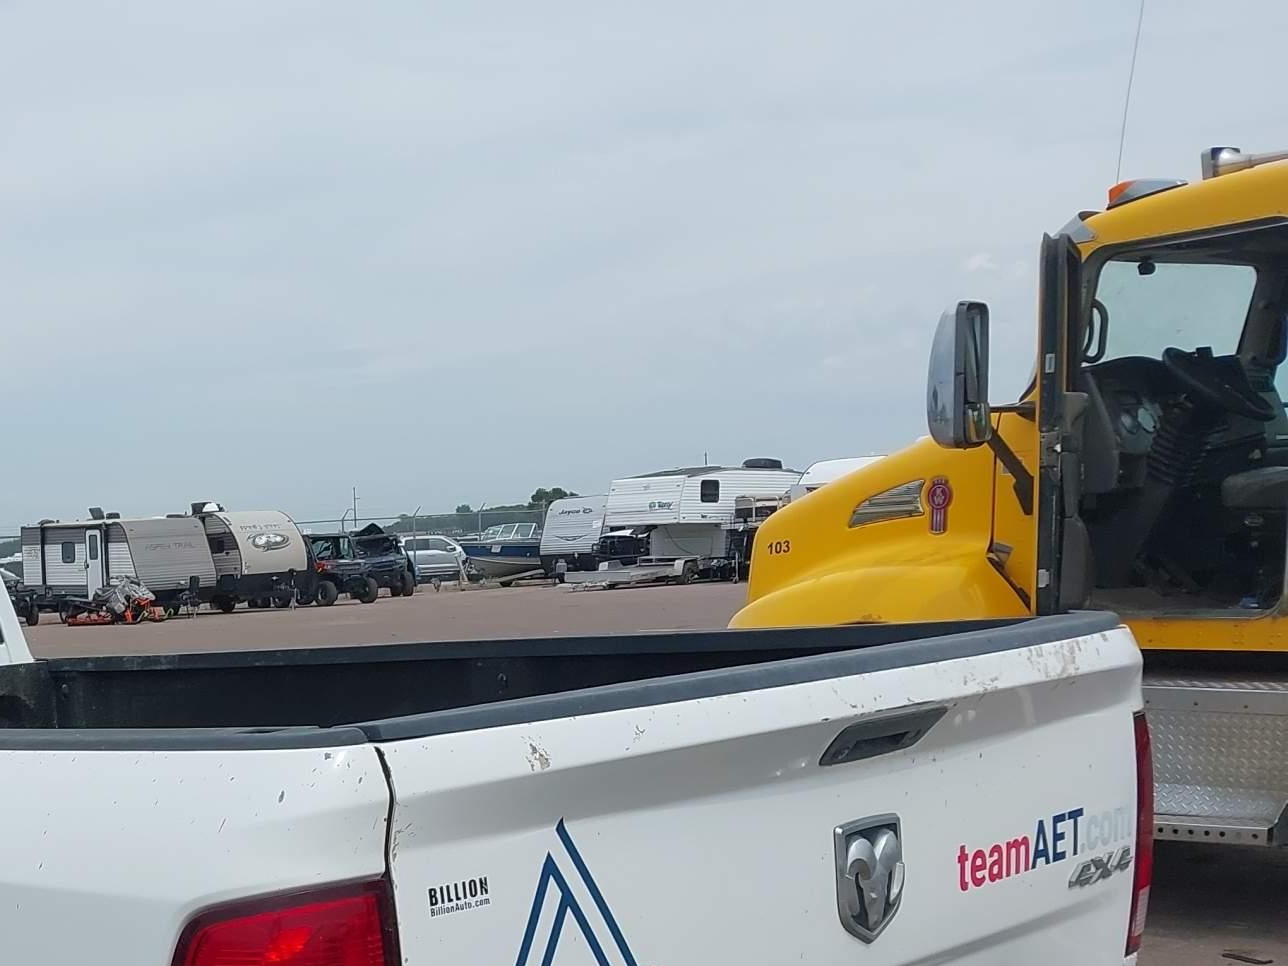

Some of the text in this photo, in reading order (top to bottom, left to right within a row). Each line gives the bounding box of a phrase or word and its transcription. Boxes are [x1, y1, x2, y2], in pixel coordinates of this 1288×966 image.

[767, 540, 791, 556] 103
[428, 876, 489, 907] BILLION
[430, 897, 491, 918] BillionAuto.com
